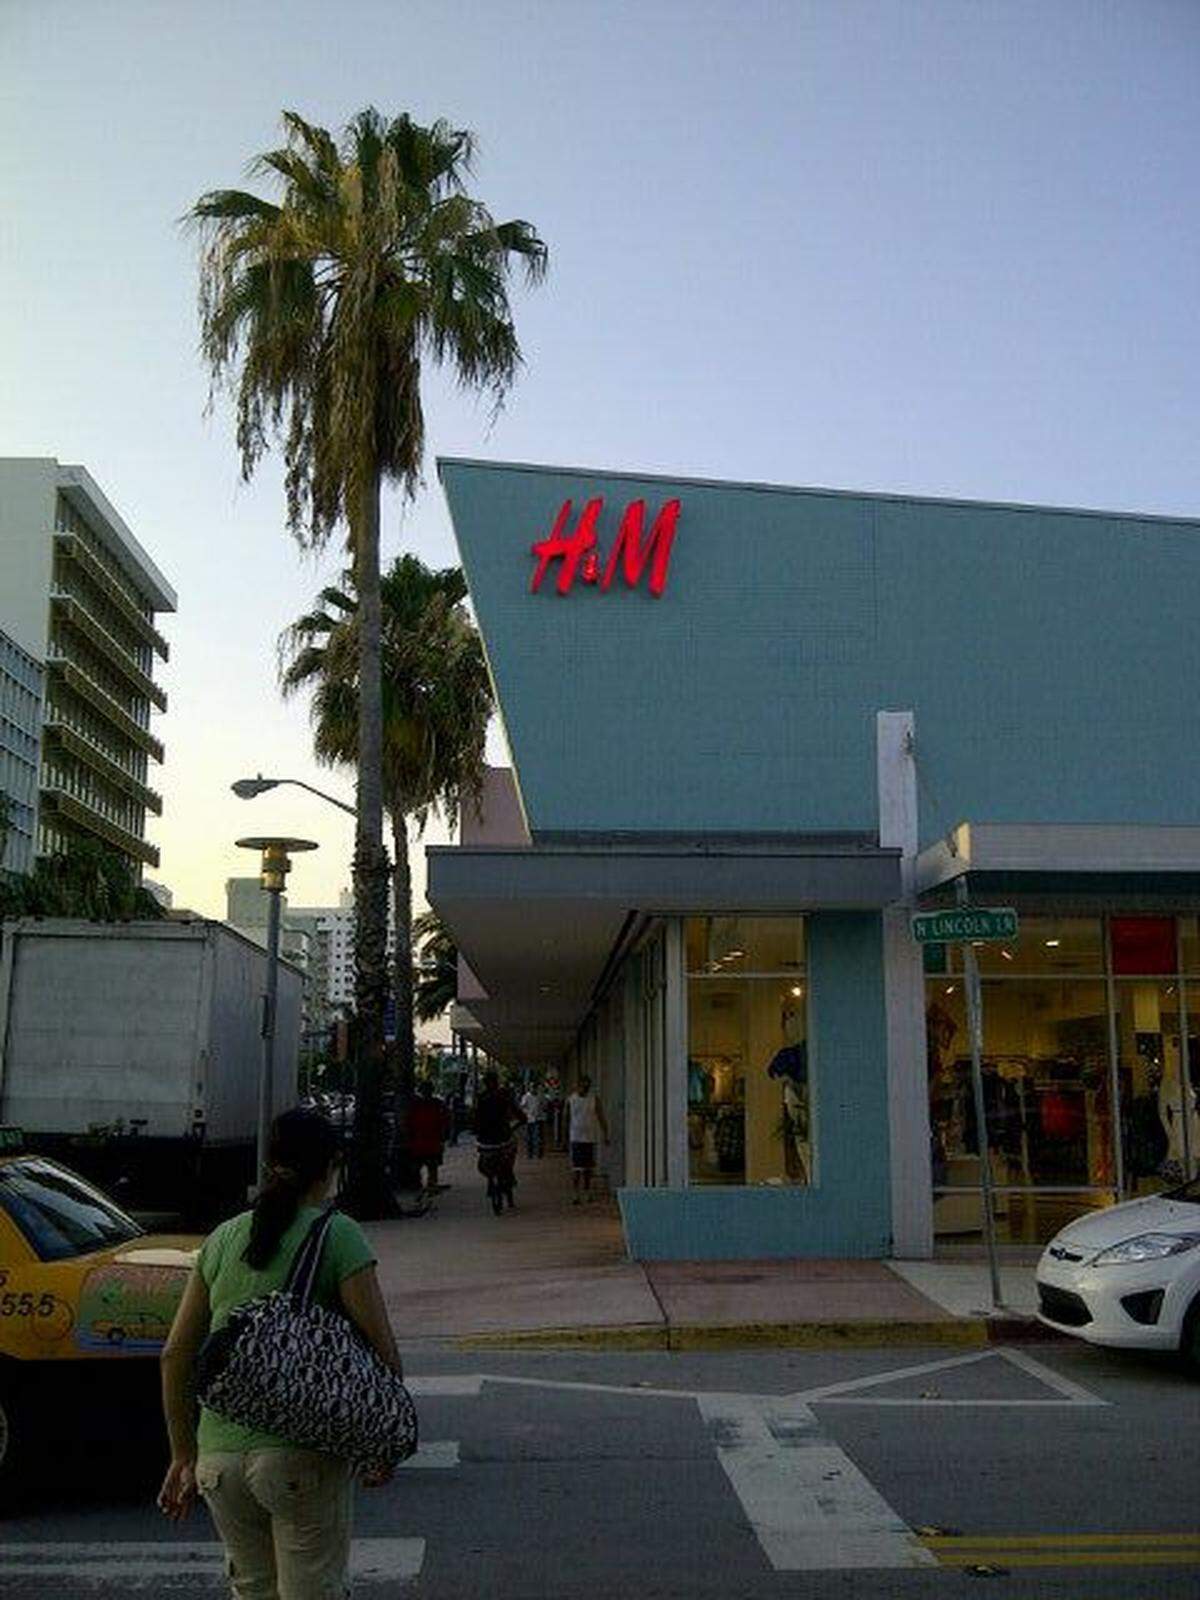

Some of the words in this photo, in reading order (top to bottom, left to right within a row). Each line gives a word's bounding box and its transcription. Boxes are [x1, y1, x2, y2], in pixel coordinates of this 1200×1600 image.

[530, 496, 681, 598] H&M
[916, 919, 927, 937] N
[932, 916, 991, 936] LINCOLN
